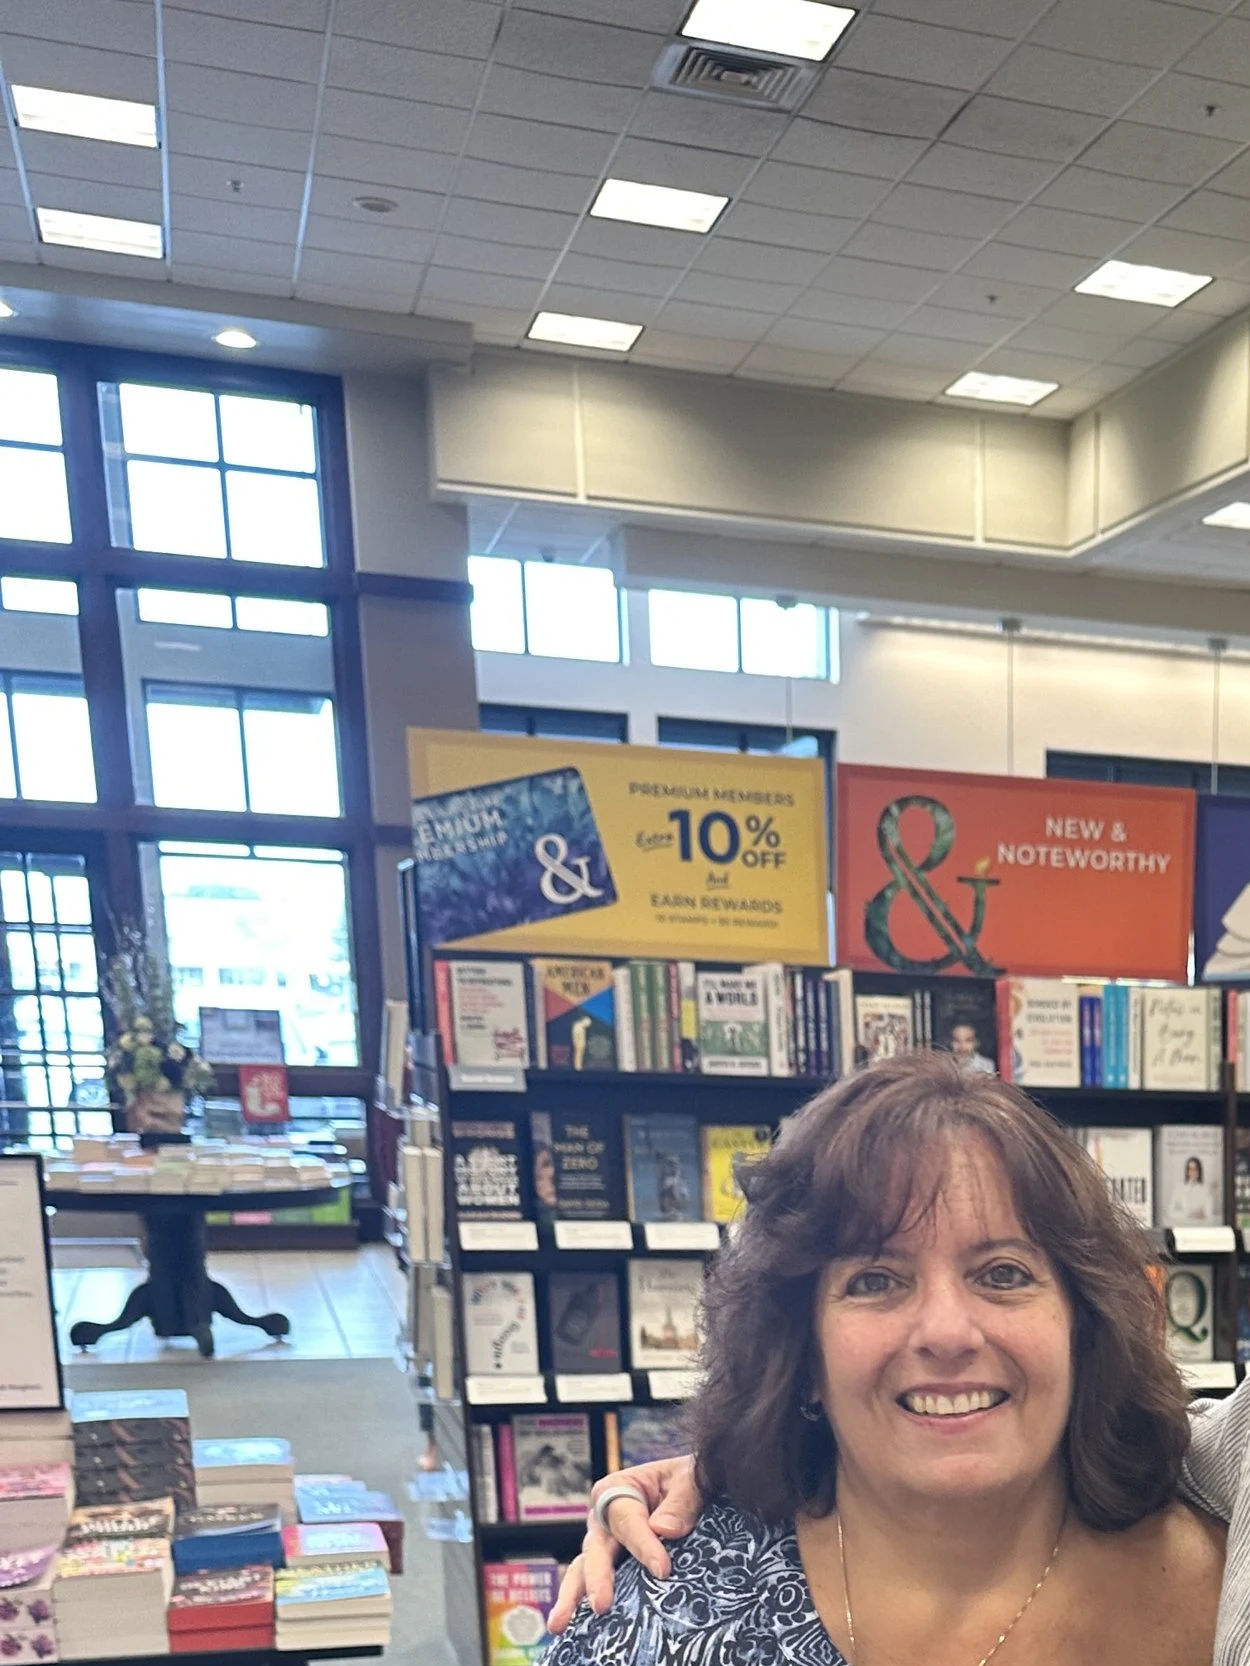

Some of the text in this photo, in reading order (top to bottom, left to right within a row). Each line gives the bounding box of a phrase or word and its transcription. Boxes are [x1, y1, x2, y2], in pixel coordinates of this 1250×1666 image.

[629, 782, 795, 806] PREMIUM MEMBERS
[1046, 817, 1128, 842] NEW &
[741, 850, 786, 869] OFF
[998, 843, 1171, 875] NOTEWORTHY
[650, 894, 783, 914] EARN REWARDS
[1167, 1272, 1208, 1343] Q
